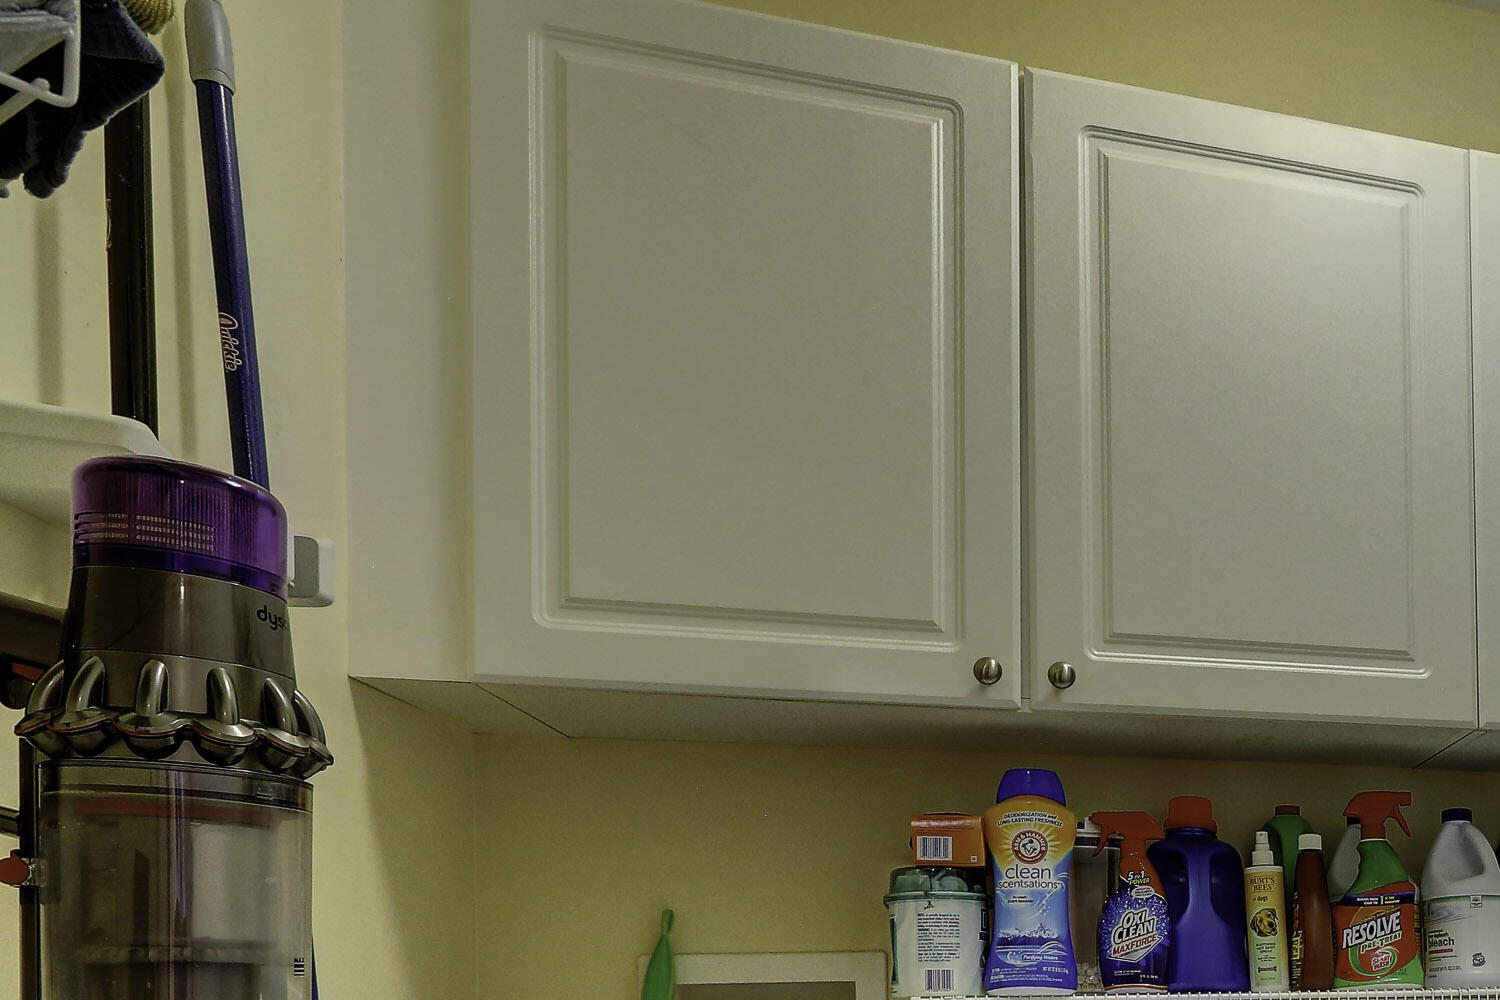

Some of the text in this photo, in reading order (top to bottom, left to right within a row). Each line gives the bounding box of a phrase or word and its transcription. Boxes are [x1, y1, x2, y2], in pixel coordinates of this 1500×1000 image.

[1005, 864, 1051, 879] clean
[999, 880, 1058, 889] scentsations
[1253, 883, 1272, 892] BEES
[1123, 909, 1148, 929] OXI
[1113, 918, 1155, 944] CLEAN
[1342, 911, 1401, 949] RESOLVE
[1113, 934, 1157, 956] MAXFORCE
